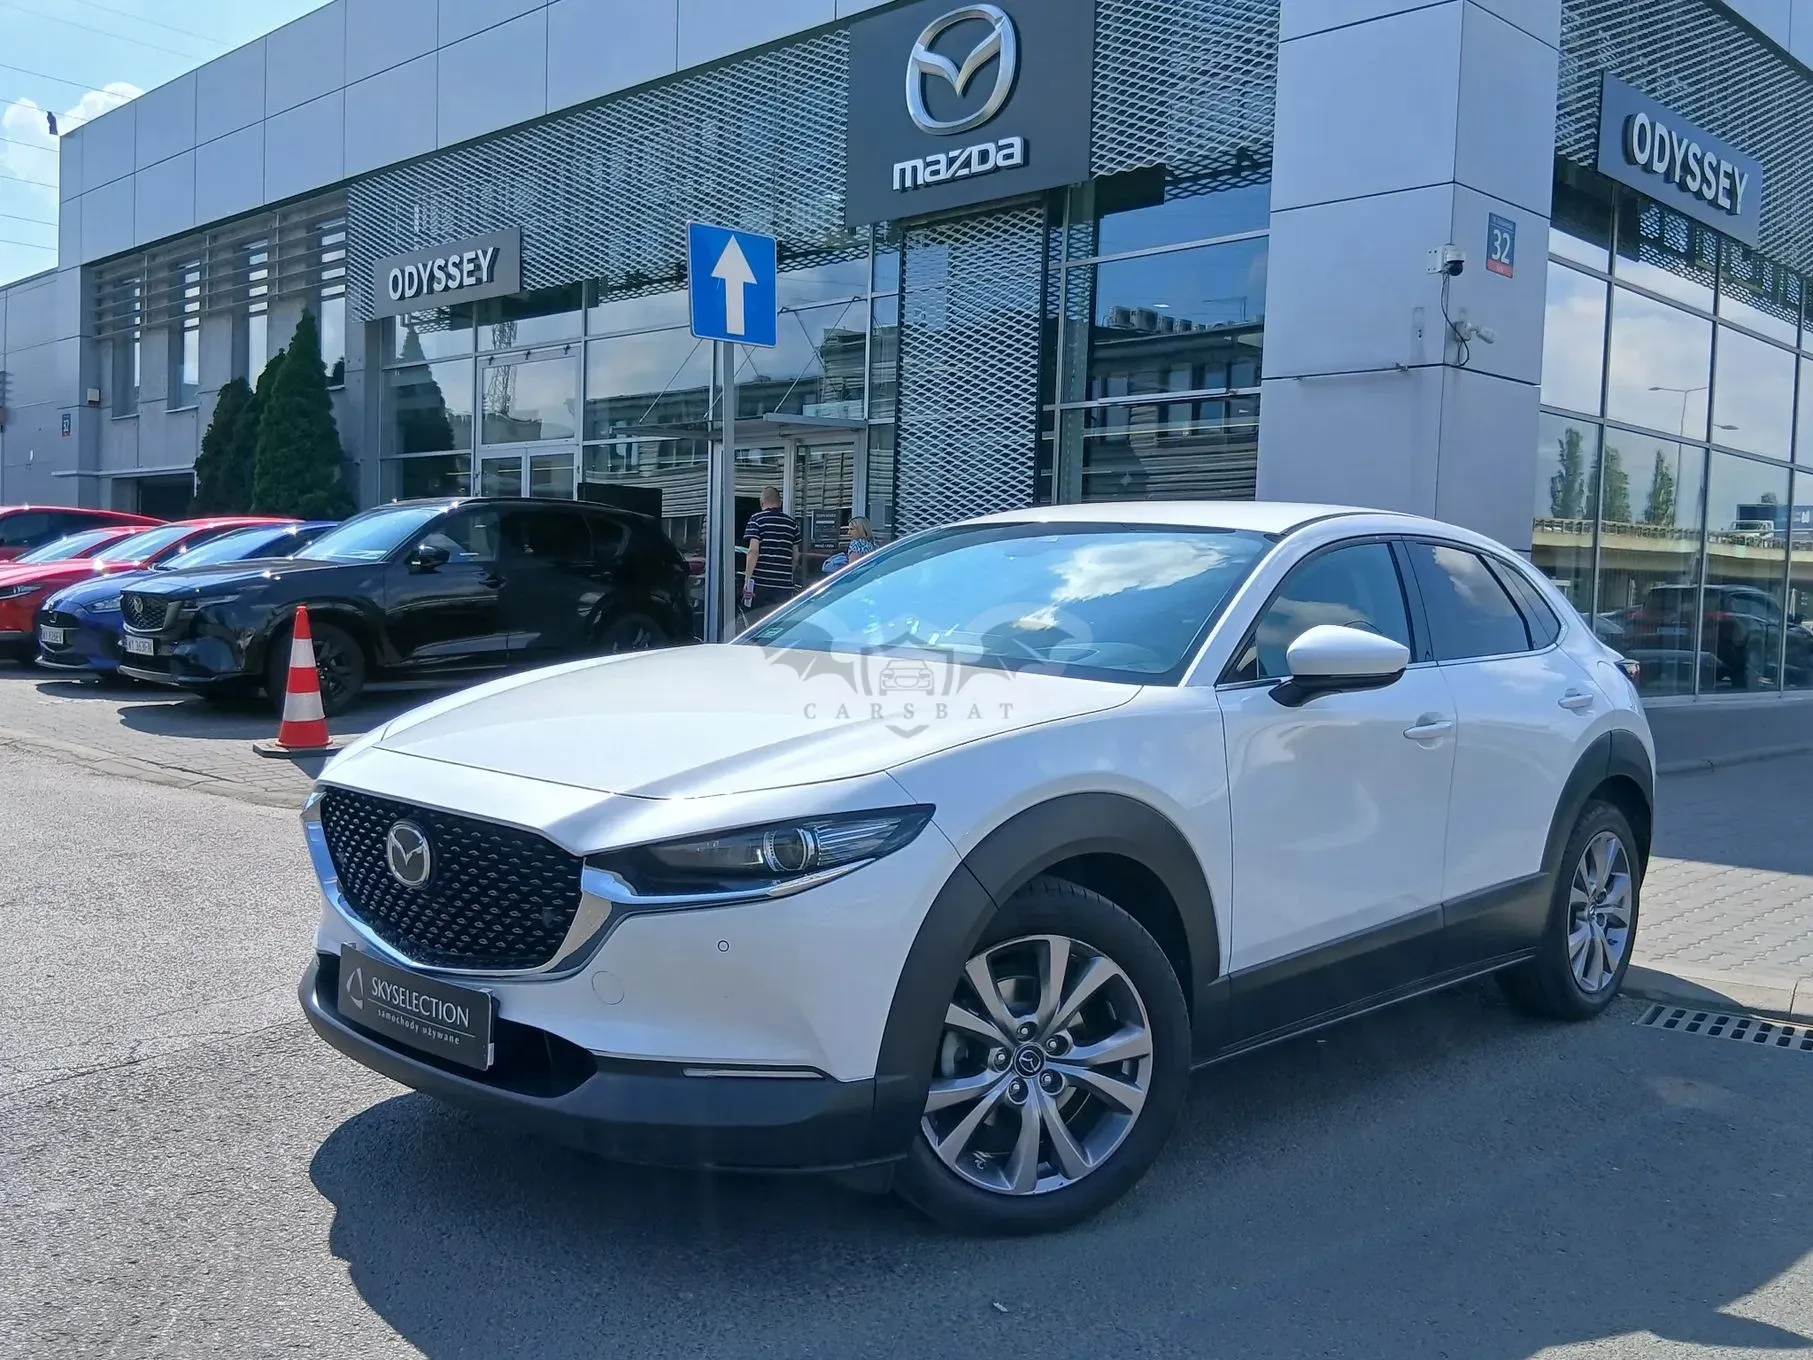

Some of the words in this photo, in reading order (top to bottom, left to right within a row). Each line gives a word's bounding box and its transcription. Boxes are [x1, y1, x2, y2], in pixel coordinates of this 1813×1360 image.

[892, 136, 1025, 191] mazda
[1633, 112, 1749, 215] ODYSSEY
[388, 246, 496, 301] ODYSSEY
[1491, 229, 1511, 265] 32
[371, 976, 470, 1028] SKYSELECTION
[377, 1008, 420, 1034] samochody
[422, 1024, 461, 1046] używane
